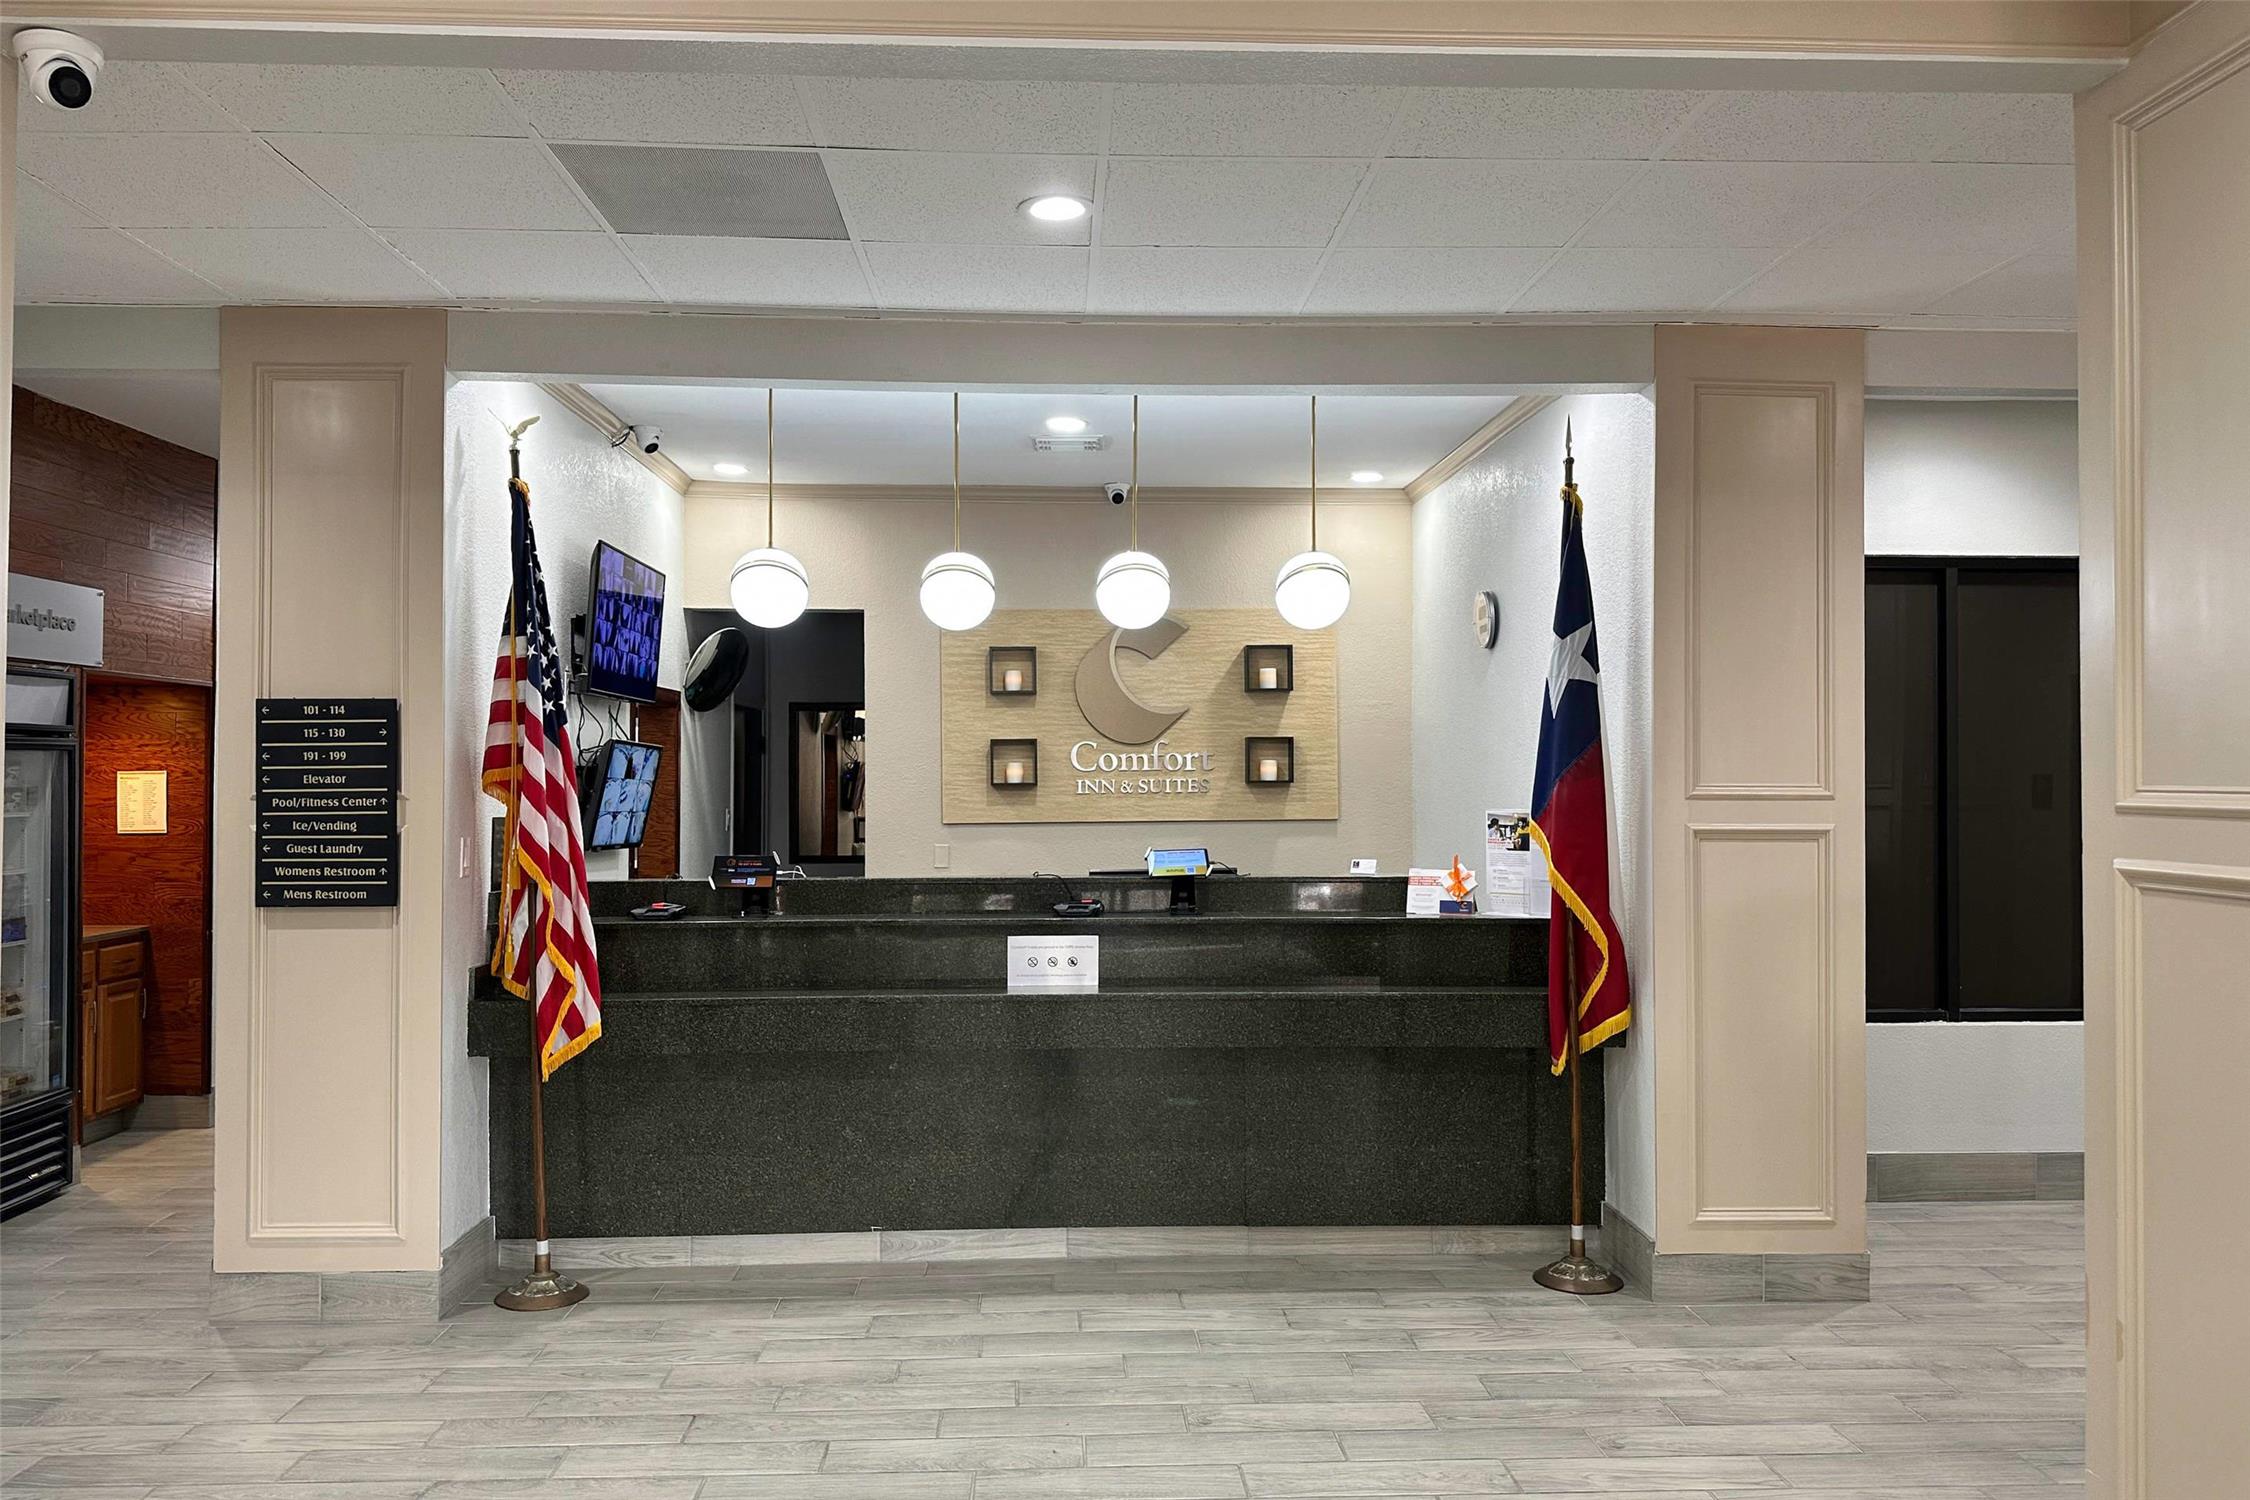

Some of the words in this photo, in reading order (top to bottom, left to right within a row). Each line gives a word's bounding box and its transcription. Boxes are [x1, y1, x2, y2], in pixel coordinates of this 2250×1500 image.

[7, 604, 77, 632] rketplace
[303, 705, 319, 714] 101
[329, 705, 346, 714] 114
[303, 728, 319, 738] 115
[328, 728, 346, 737] 130
[303, 751, 319, 760] 191
[329, 751, 347, 760] 199
[1070, 739, 1216, 772] Comfort
[303, 774, 347, 784] Elevator
[1076, 779, 1116, 794] INN
[1120, 779, 1134, 794] &
[1138, 778, 1210, 794] SUITES
[272, 797, 339, 809] Pool/Fitness
[341, 797, 378, 807] Center
[292, 821, 357, 833] Ice/Vending
[286, 843, 318, 854] Guest
[320, 843, 363, 855] Laundry
[274, 867, 321, 876] Womens
[323, 867, 376, 876] Restroom
[283, 889, 313, 899] Mens
[315, 889, 367, 899] Restroom
